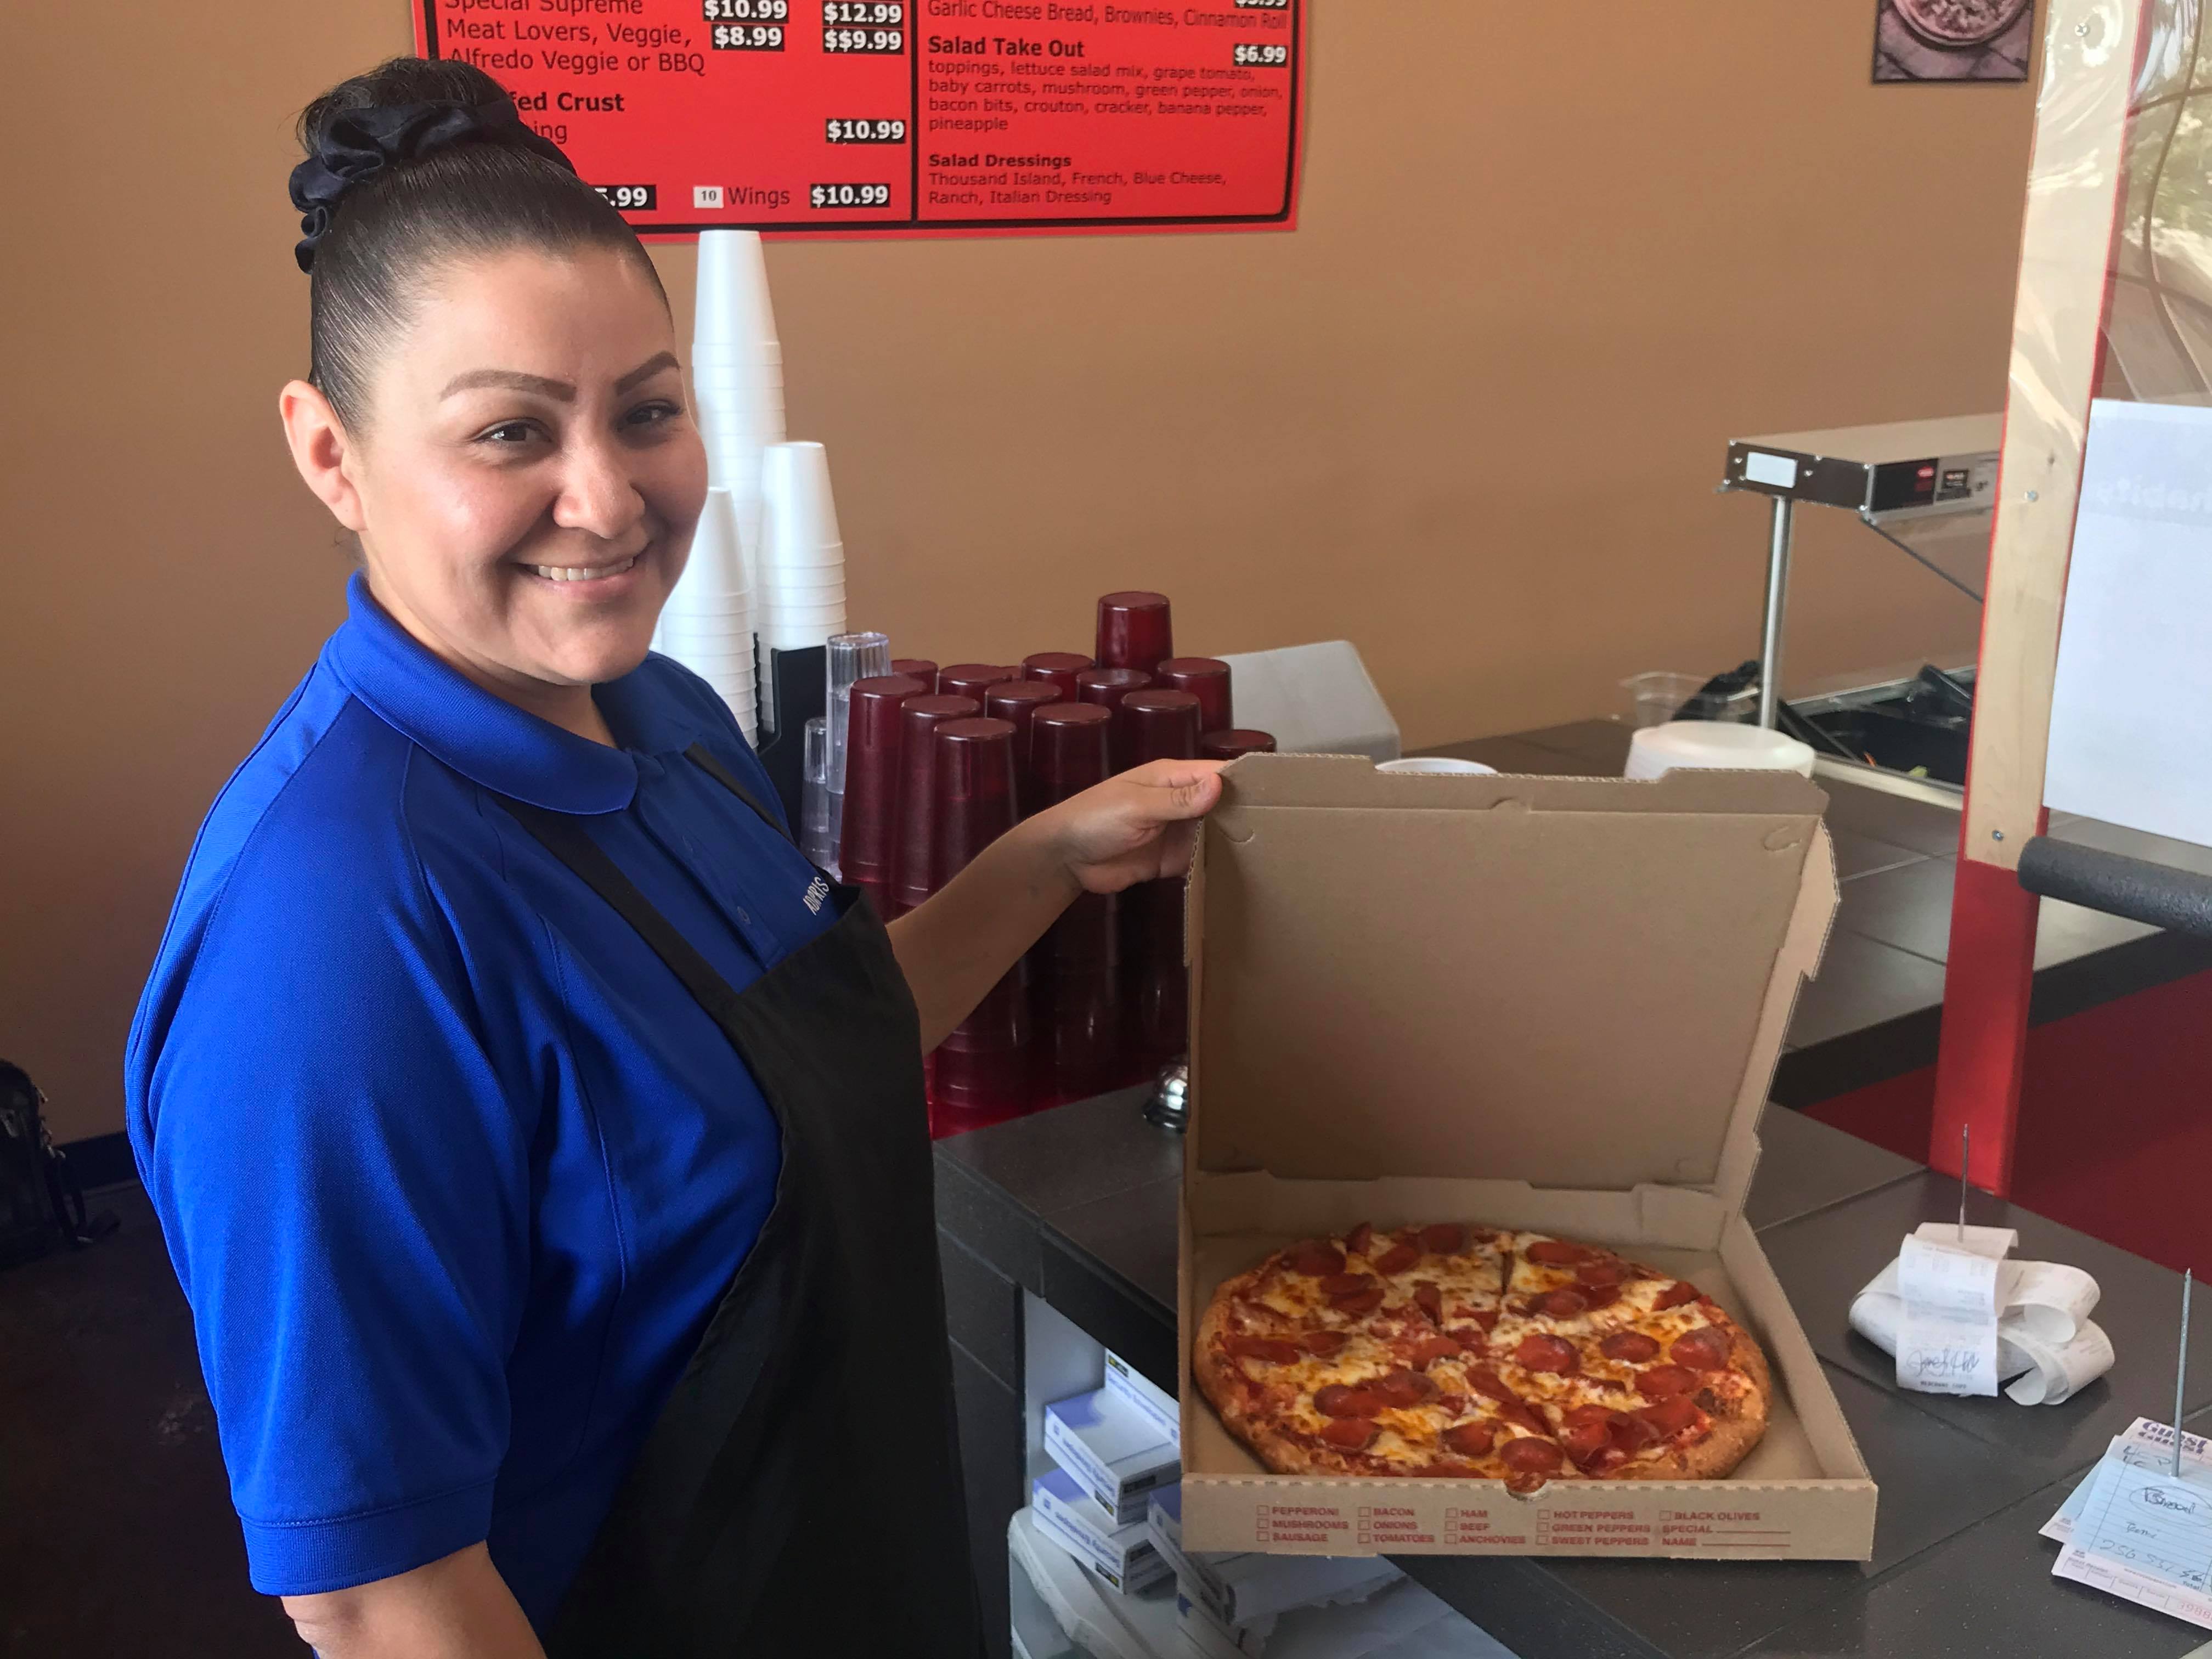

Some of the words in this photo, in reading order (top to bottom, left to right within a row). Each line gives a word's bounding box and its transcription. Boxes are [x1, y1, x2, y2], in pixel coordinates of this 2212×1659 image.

[539, 0, 643, 16] Supreme
[704, 0, 787, 20] $10.99
[825, 2, 902, 25] $12.99
[928, 0, 977, 17] Garlic
[983, 1, 1042, 20] Cheese
[1048, 4, 1098, 25] Bread,
[1105, 5, 1178, 27] Brownies,
[1184, 9, 1256, 28] Cinnamon
[447, 19, 505, 40] Meat
[515, 20, 597, 45] Lovers,
[607, 22, 691, 48] Veggie,
[715, 26, 782, 49] $8.99
[825, 29, 902, 52] $$9.99
[928, 36, 986, 54] Salad
[992, 38, 1042, 55] Take
[1048, 40, 1084, 57] Out
[452, 48, 533, 70] Alfredo
[541, 50, 618, 75] Veggie
[627, 56, 650, 71] or
[659, 53, 706, 77] BBQ
[1235, 46, 1286, 65] $6.99
[928, 60, 1005, 76] toppings,
[1011, 61, 1065, 76] lettuce
[1071, 64, 1110, 77] salad
[1116, 65, 1148, 79] mix,
[1153, 67, 1195, 81] grape
[1200, 67, 1255, 81] tomato,
[929, 78, 969, 94] baby
[974, 81, 1036, 95] carrots,
[1043, 81, 1129, 97] mushroom,
[1136, 86, 1177, 98] green
[1182, 86, 1235, 98] pepper,
[557, 92, 625, 112] Crust
[929, 98, 978, 111] bacon
[984, 98, 1018, 114] bits,
[1024, 101, 1088, 114] crouton,
[1094, 101, 1152, 115] cracker,
[1158, 102, 1211, 115] banana
[1215, 104, 1267, 116] pepper,
[828, 120, 905, 142] $10.99
[929, 117, 1008, 132] pineapple
[929, 154, 979, 167] Salad
[985, 154, 1071, 170] Dressings
[929, 172, 1007, 185] Thousand
[1014, 172, 1066, 187] Island,
[1072, 172, 1128, 187] French,
[1133, 171, 1165, 184] Blue
[1170, 171, 1226, 185] Cheese,
[701, 190, 716, 201] 10
[728, 187, 790, 208] Wings
[811, 185, 888, 207] $10.99
[929, 191, 983, 206] Ranch,
[990, 190, 1040, 204] Italian
[1047, 190, 1112, 205] Dressing
[1272, 1506, 1339, 1515] PEPPERONI
[1373, 1508, 1415, 1516] BACON
[1460, 1510, 1487, 1518] HAM
[1553, 1511, 1577, 1519] HOT
[1581, 1511, 1633, 1520] PEPPERS
[1674, 1512, 1714, 1520] BLACK
[1718, 1512, 1760, 1521] OLIVES
[1272, 1520, 1348, 1529] MUSHROOMS
[1374, 1521, 1418, 1530] ONIONS
[1552, 1524, 1593, 1532] GREEN
[1597, 1525, 1650, 1533] PEPPERS
[1662, 1525, 1713, 1534] SPECIAL
[1273, 1533, 1328, 1542] SAUSAGE
[1374, 1533, 1435, 1543] TOMATOES
[1459, 1536, 1526, 1544] ANCHOVIES
[1552, 1537, 1590, 1545] SWEET
[1595, 1537, 1649, 1546] PEPPERS
[1662, 1538, 1696, 1546] NAME
